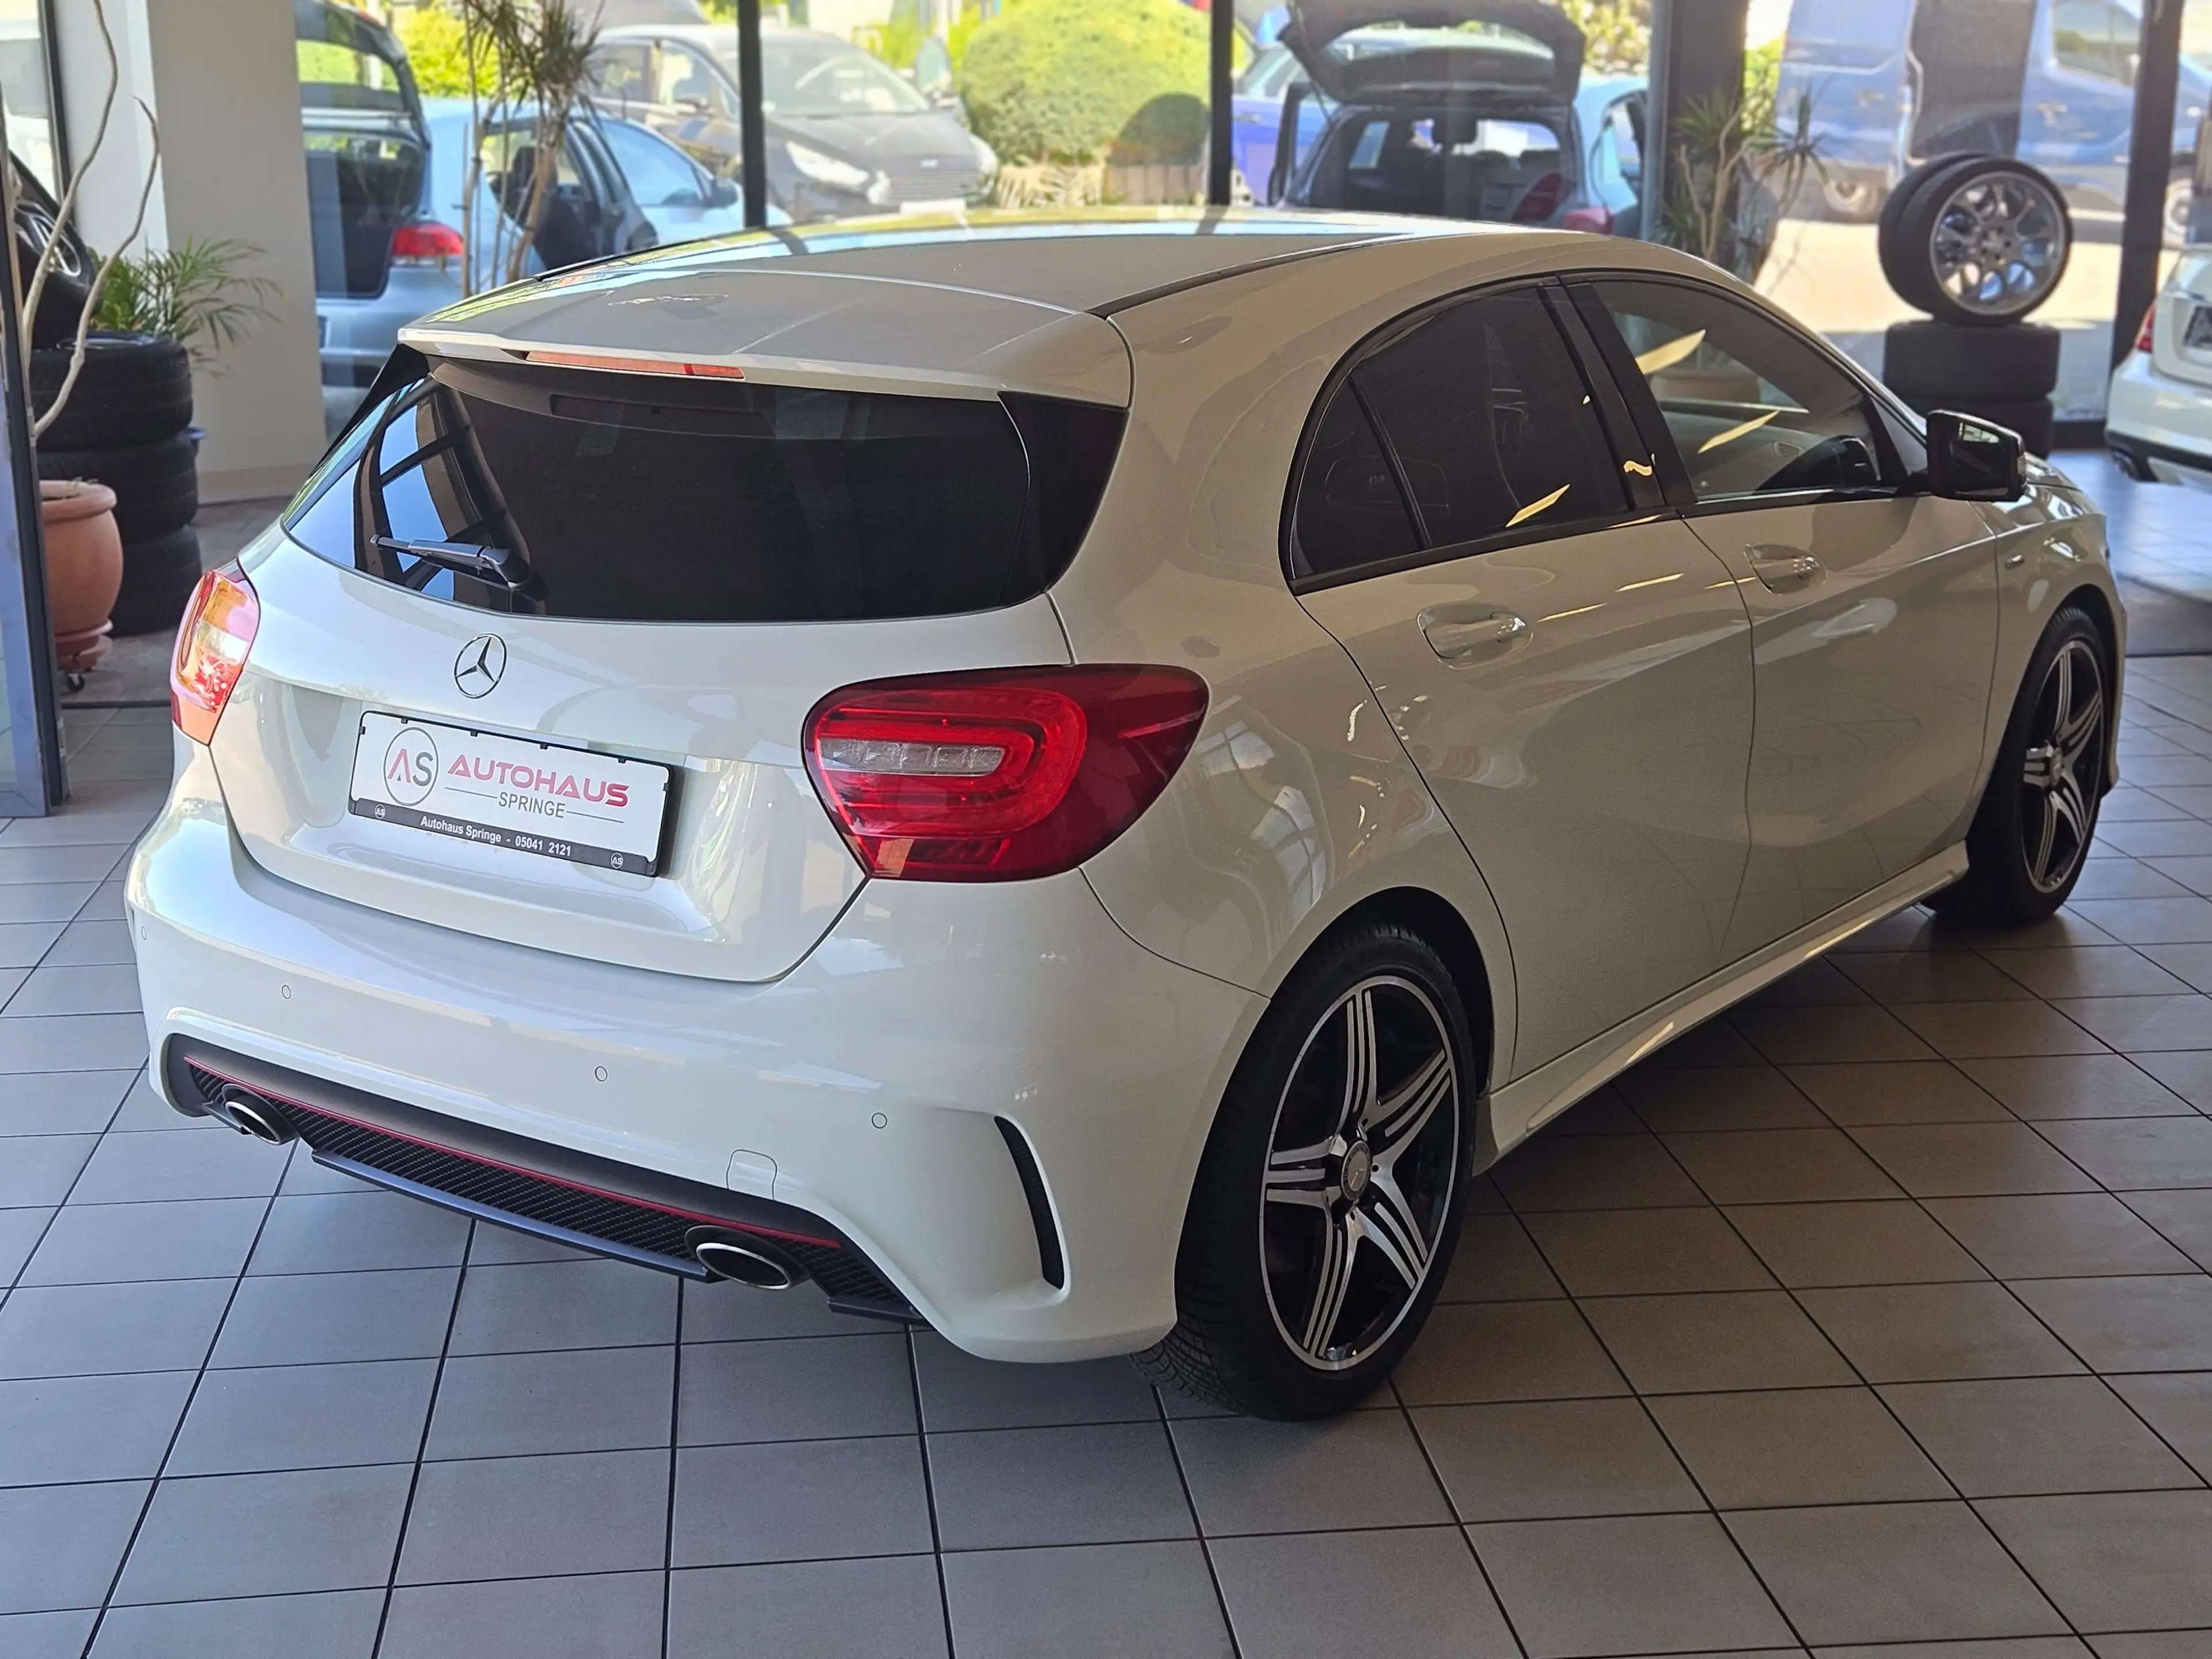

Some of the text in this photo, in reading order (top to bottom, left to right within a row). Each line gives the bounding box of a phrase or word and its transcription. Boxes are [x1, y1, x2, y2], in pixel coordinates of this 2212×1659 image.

[448, 754, 629, 807] AUTOHAUS
[498, 791, 566, 818] SPRINGE
[421, 816, 463, 835] Autohaus
[465, 825, 501, 843] Springe
[515, 835, 543, 851] 05041
[548, 842, 571, 857] 2121
